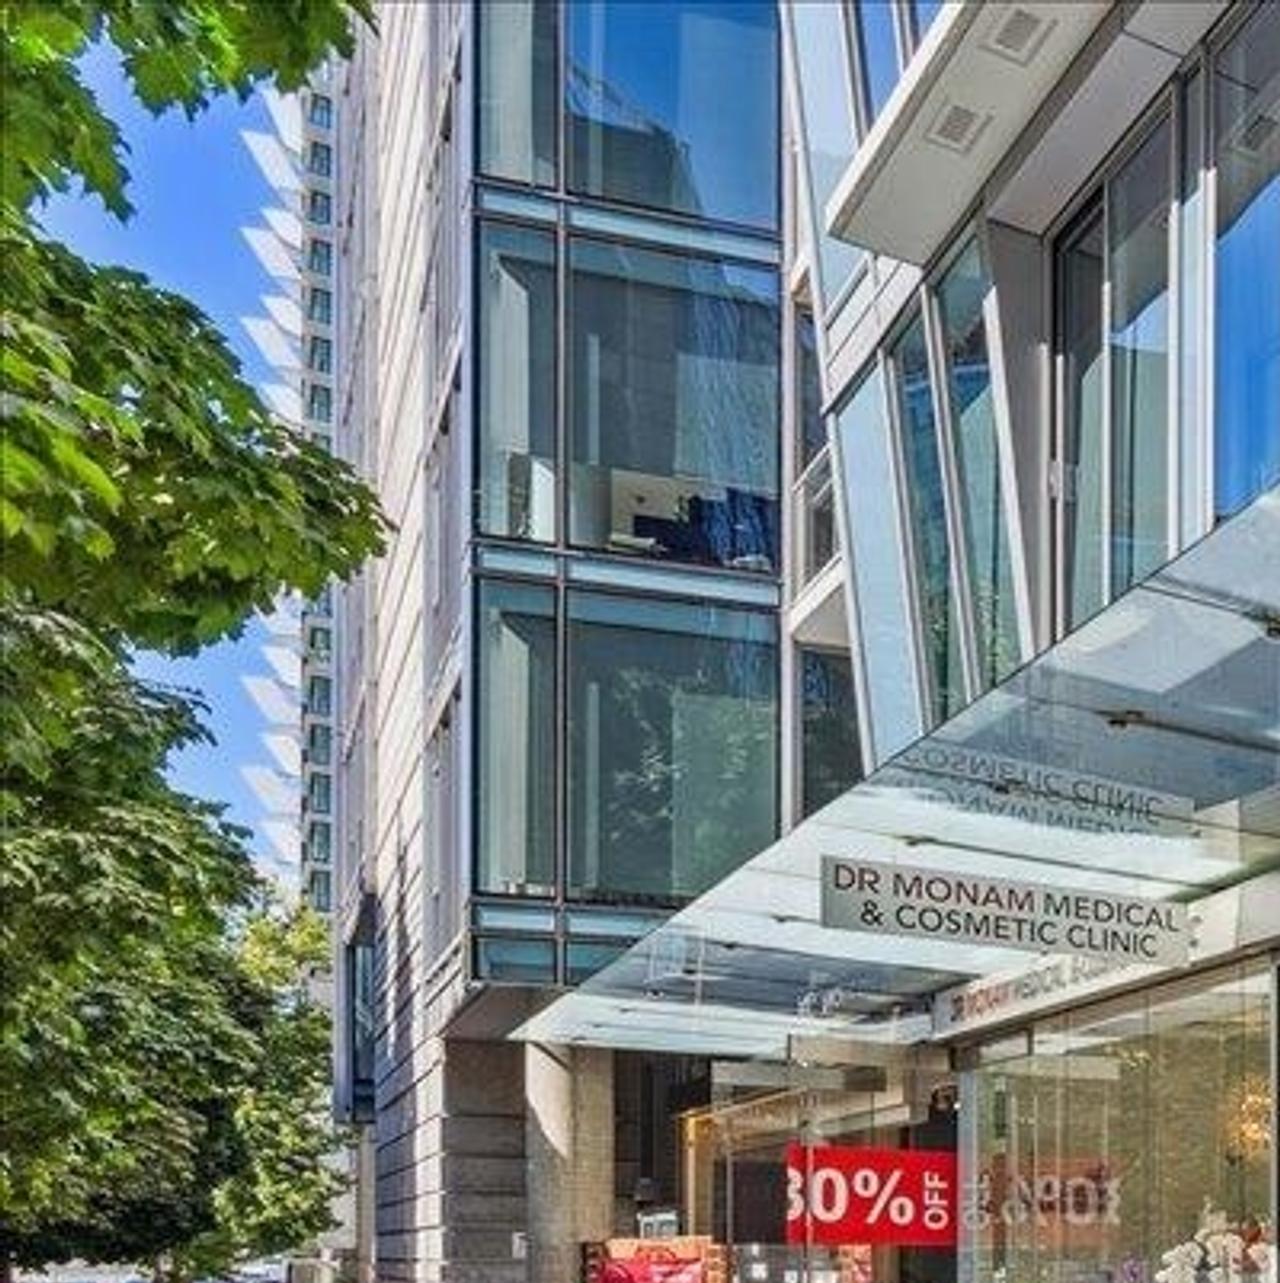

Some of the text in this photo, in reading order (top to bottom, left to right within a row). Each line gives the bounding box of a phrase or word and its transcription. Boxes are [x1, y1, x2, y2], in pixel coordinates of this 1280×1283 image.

[833, 864, 1181, 933] DR MONAM MEDICAL
[859, 900, 1158, 959] & COSMETIC CLINIC
[924, 1171, 949, 1230] OFF
